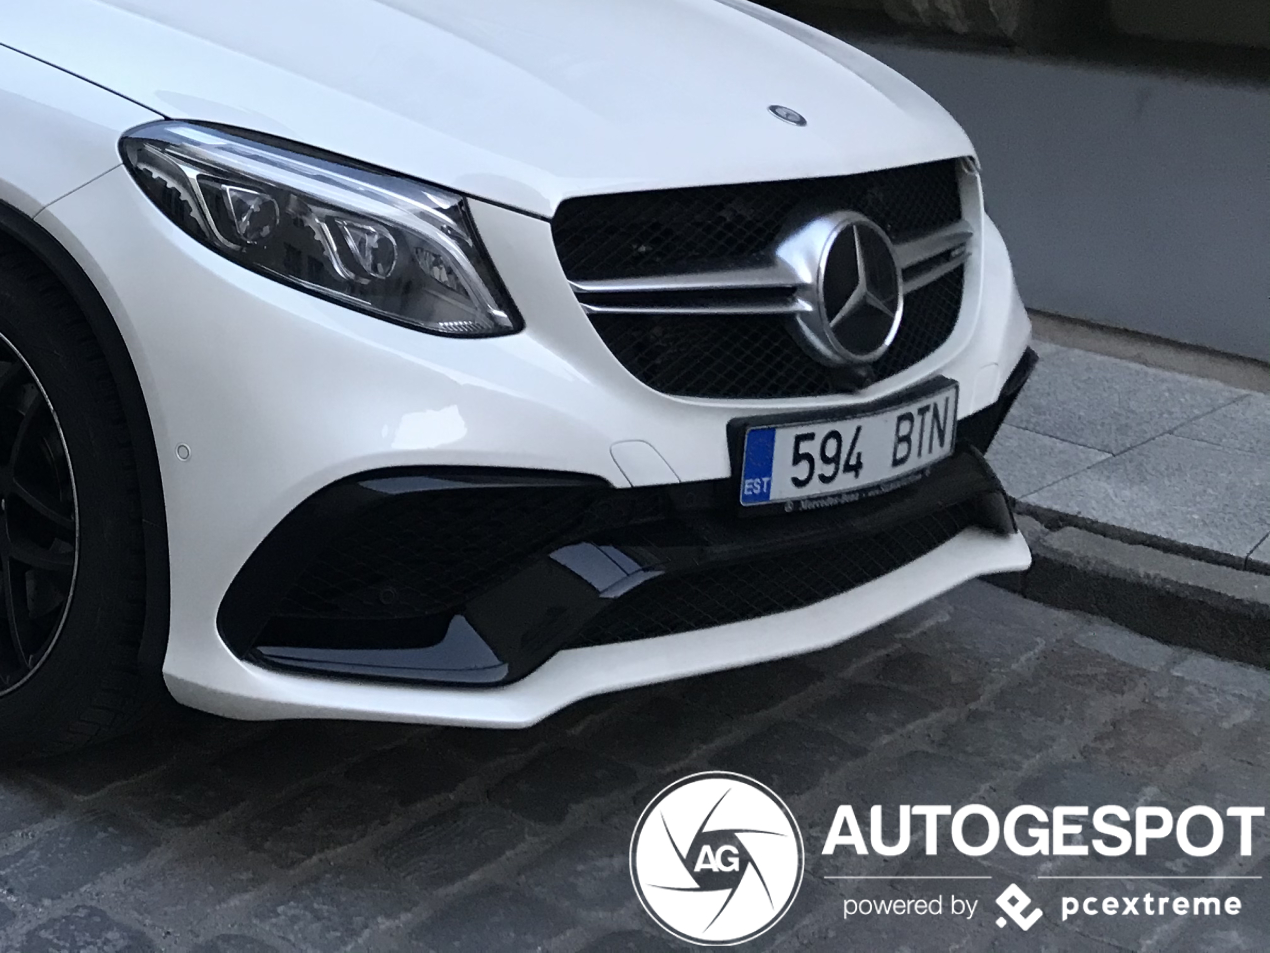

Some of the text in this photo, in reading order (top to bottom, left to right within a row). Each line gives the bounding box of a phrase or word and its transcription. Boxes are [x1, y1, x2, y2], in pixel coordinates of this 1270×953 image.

[790, 425, 863, 488] 594
[891, 396, 949, 467] BTN
[743, 477, 771, 496] EST
